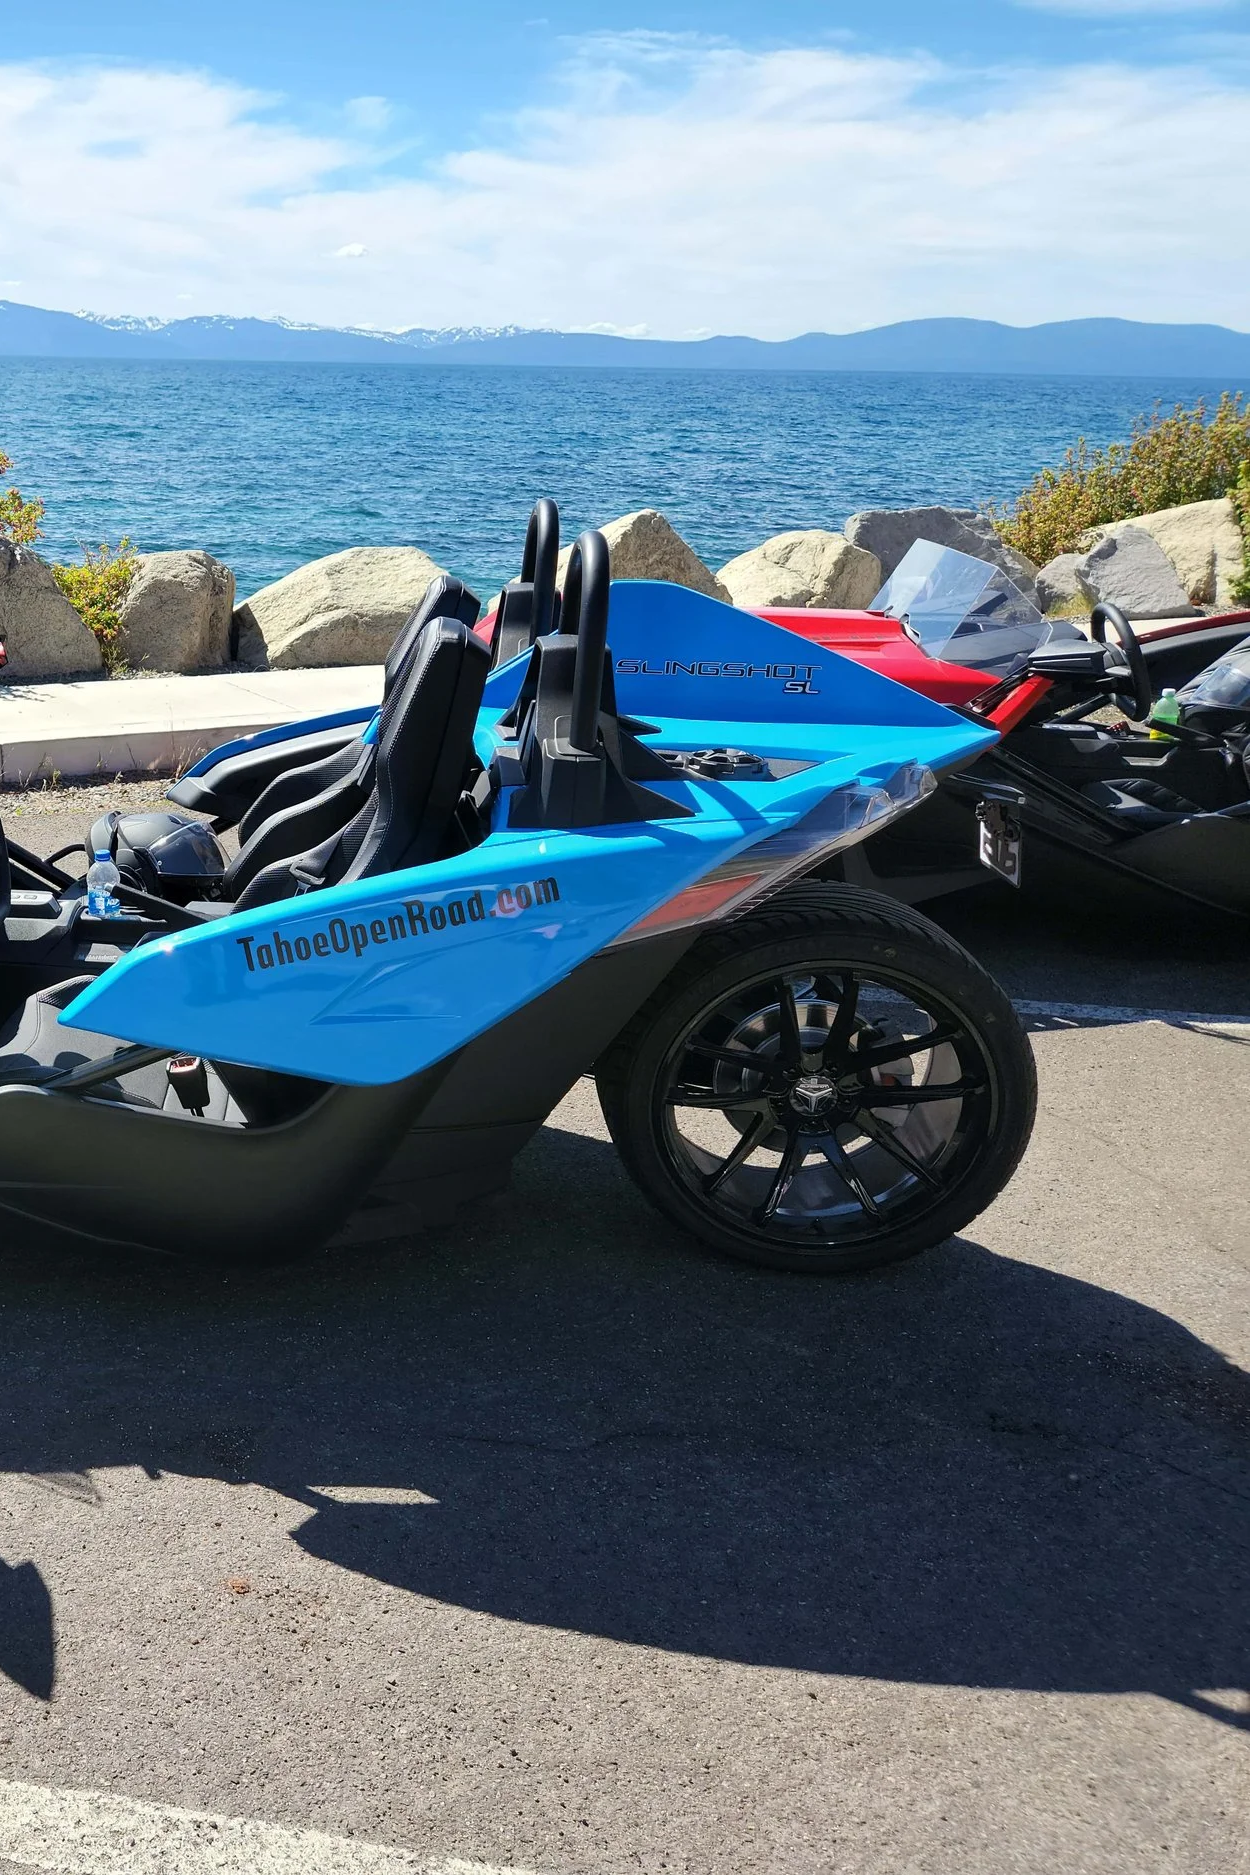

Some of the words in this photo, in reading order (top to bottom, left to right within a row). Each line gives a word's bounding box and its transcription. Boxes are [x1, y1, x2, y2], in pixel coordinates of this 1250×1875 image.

[616, 659, 823, 680] SLINGSHOT
[782, 680, 822, 694] SL
[237, 876, 561, 972] TahoeOpenRoad.com
